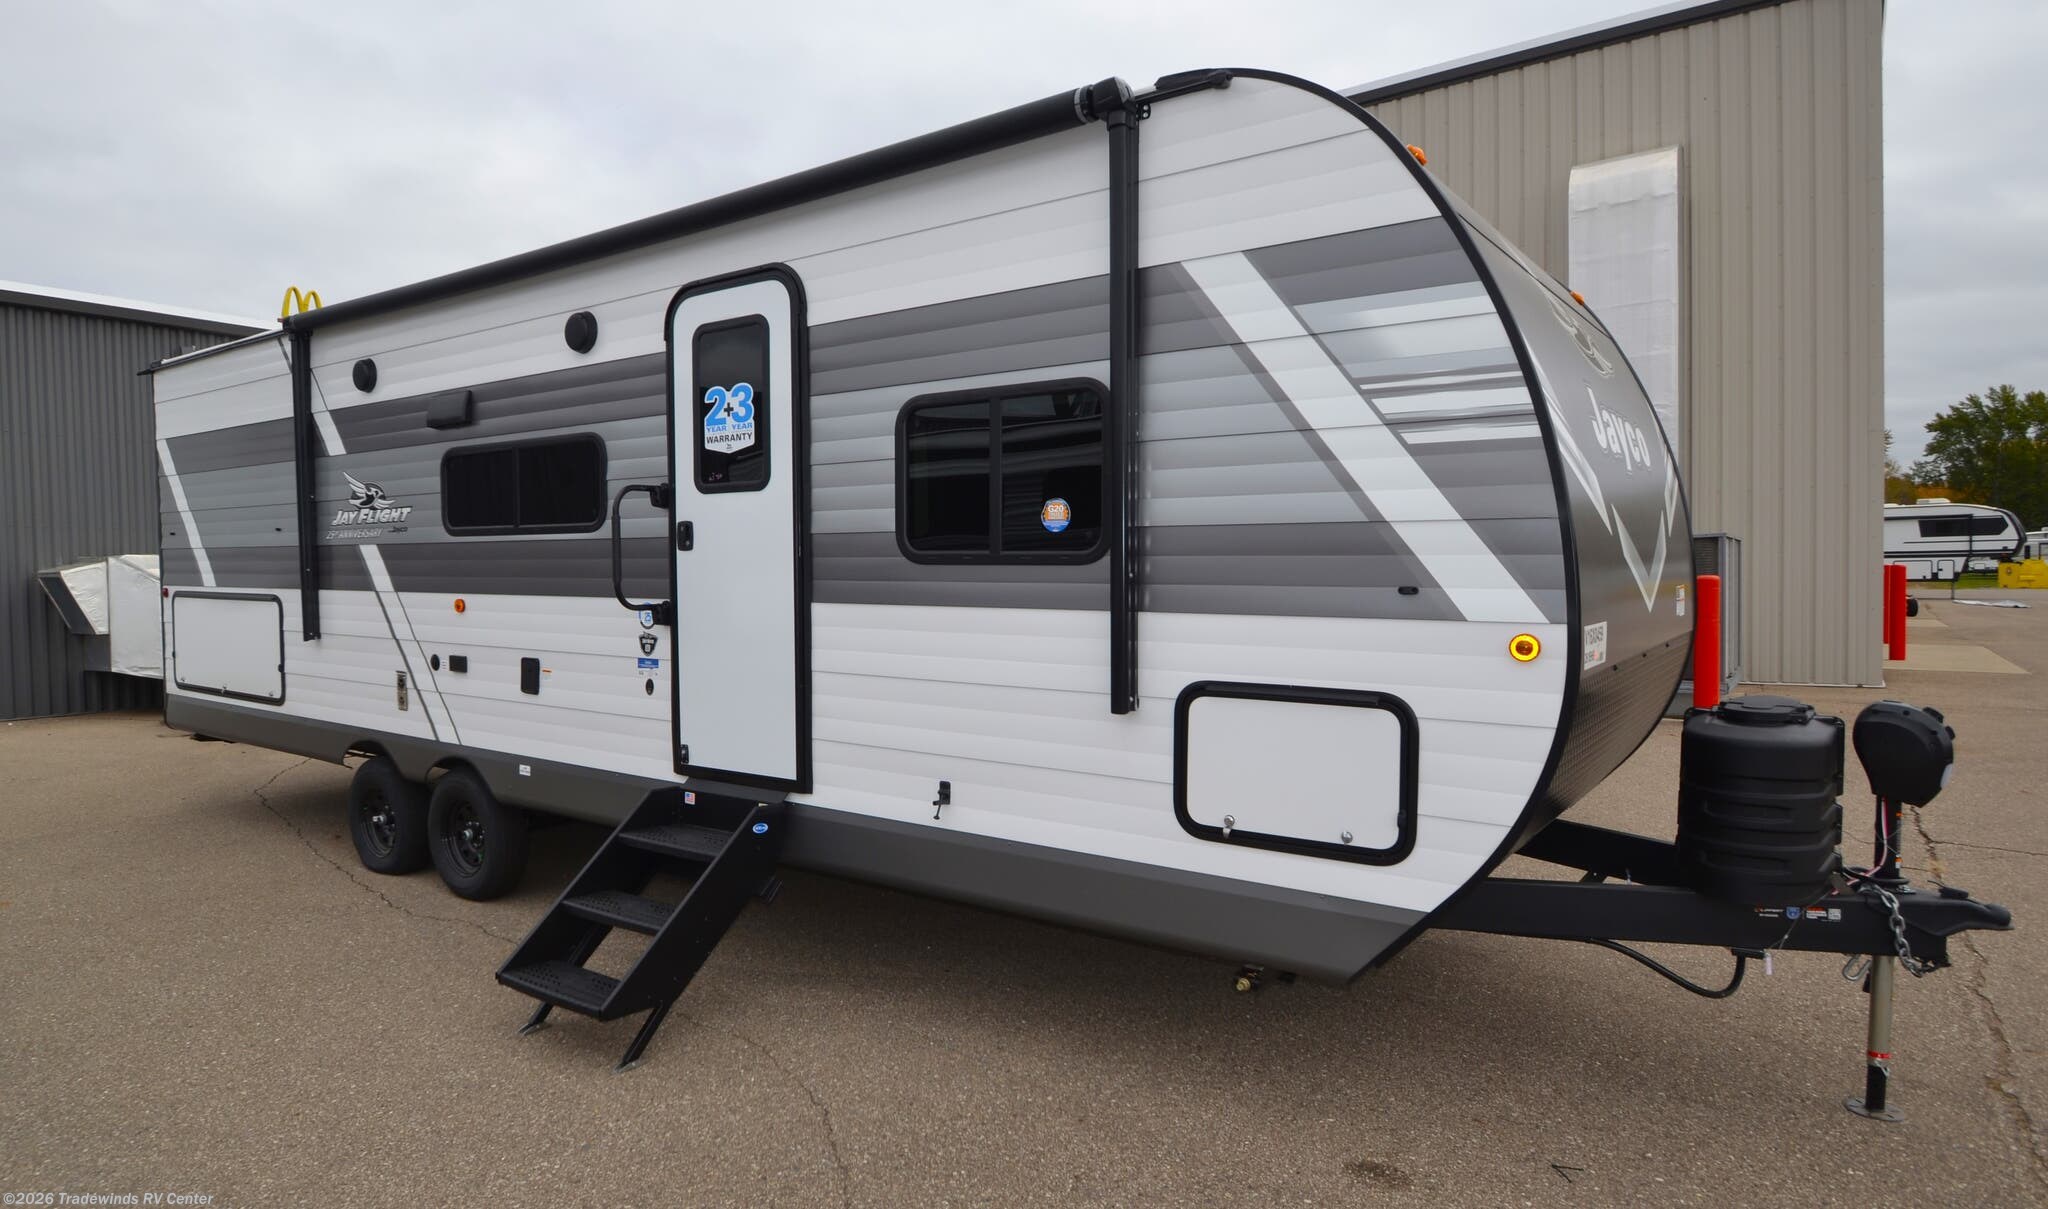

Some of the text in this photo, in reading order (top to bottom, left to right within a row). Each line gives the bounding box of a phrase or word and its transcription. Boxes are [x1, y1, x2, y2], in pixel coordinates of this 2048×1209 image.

[706, 422, 753, 433] YEAR YEAR
[1586, 386, 1651, 471] Jayco
[706, 432, 752, 444] WARRANTY
[331, 507, 412, 526] JAY FLIGHT
